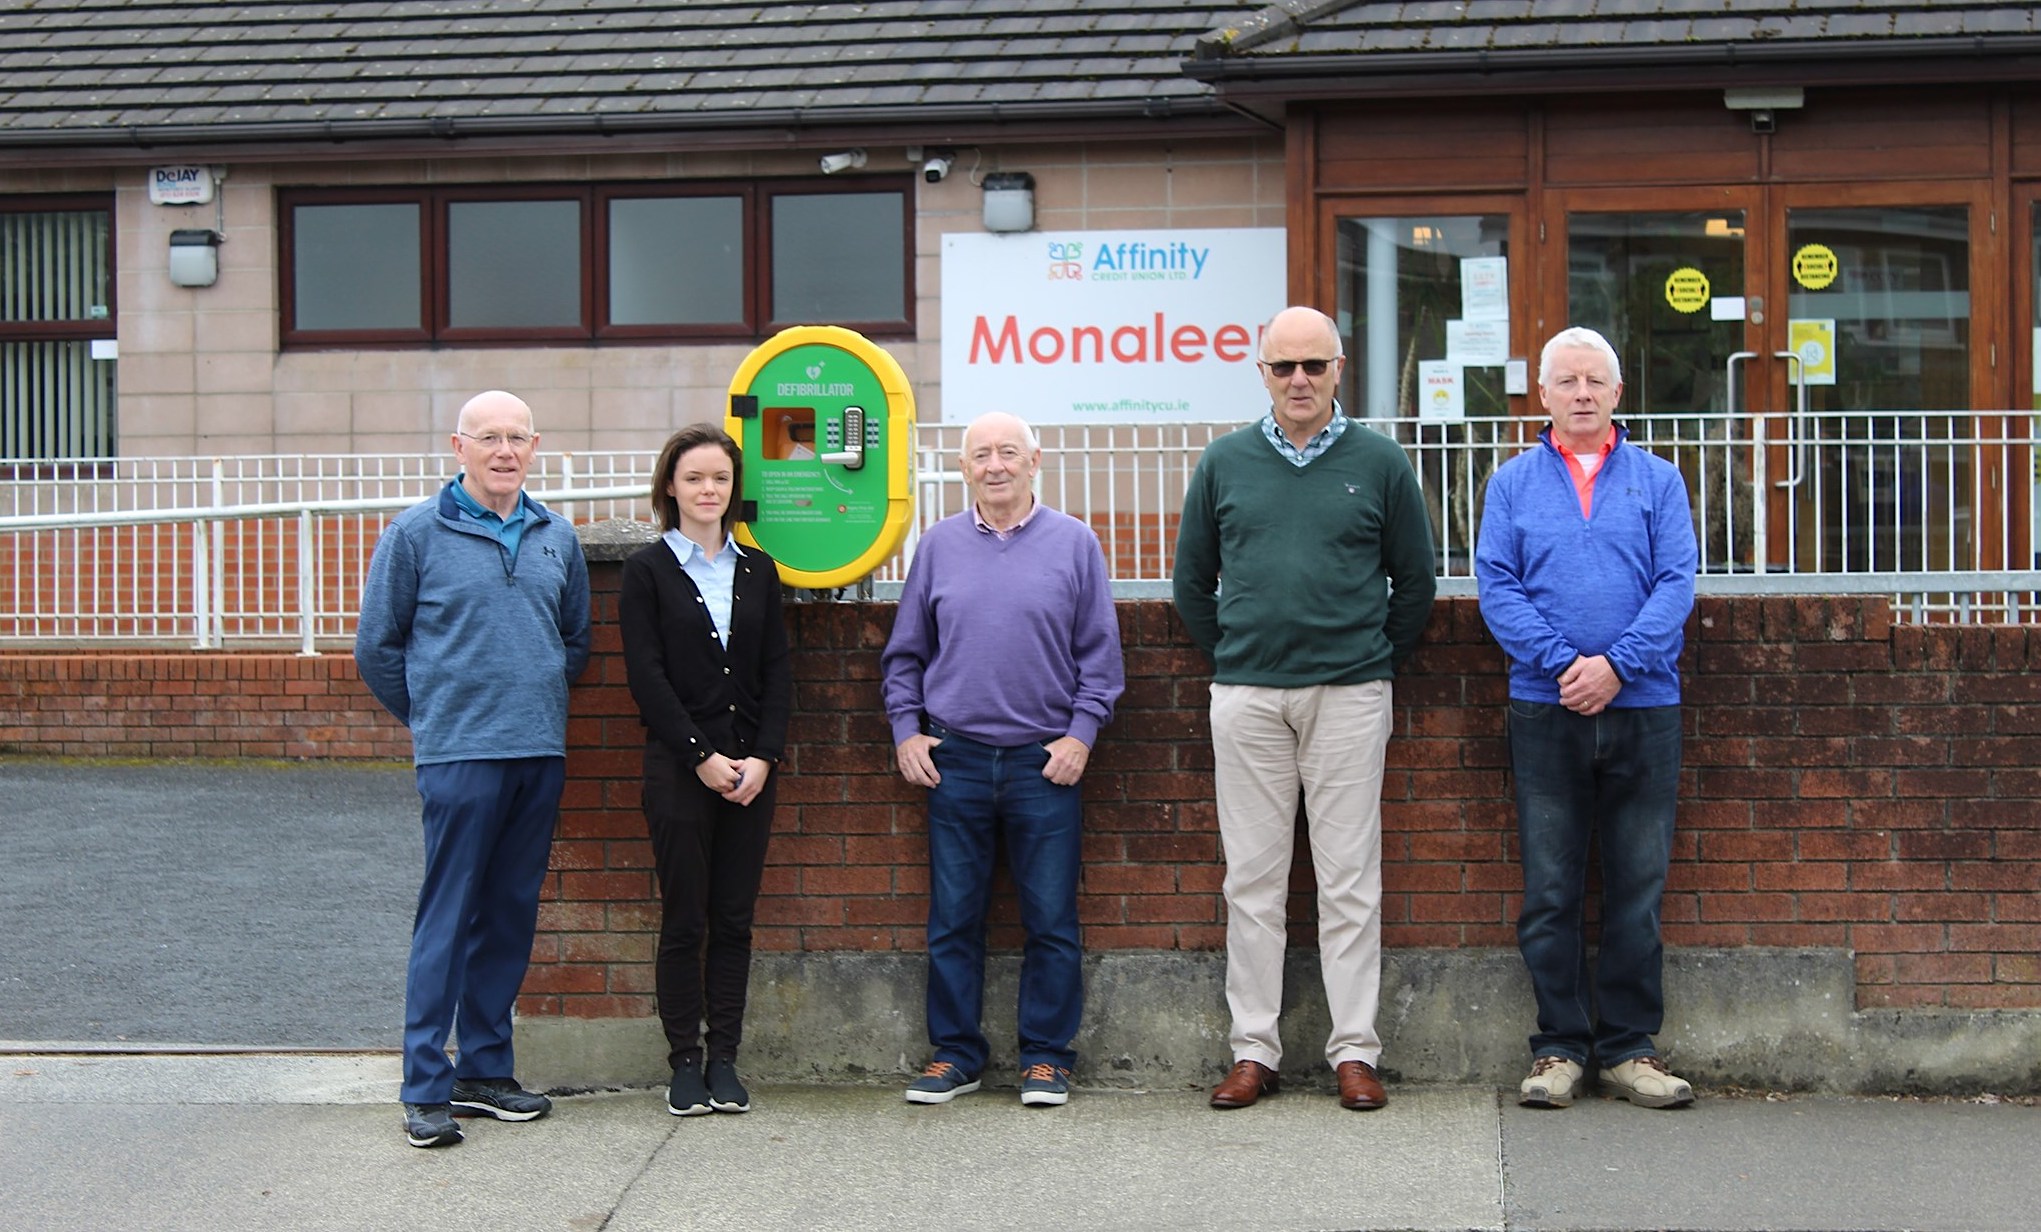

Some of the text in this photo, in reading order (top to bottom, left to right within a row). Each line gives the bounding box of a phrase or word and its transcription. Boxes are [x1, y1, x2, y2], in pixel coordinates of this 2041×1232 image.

[1093, 242, 1209, 279] Affinity
[1091, 271, 1128, 280] CREDIT
[1131, 271, 1165, 280] UNION
[969, 312, 1267, 364] Monalee
[777, 382, 854, 397] DEFIBRILLATOR
[1072, 398, 1191, 413] www.affinitycu.ie
